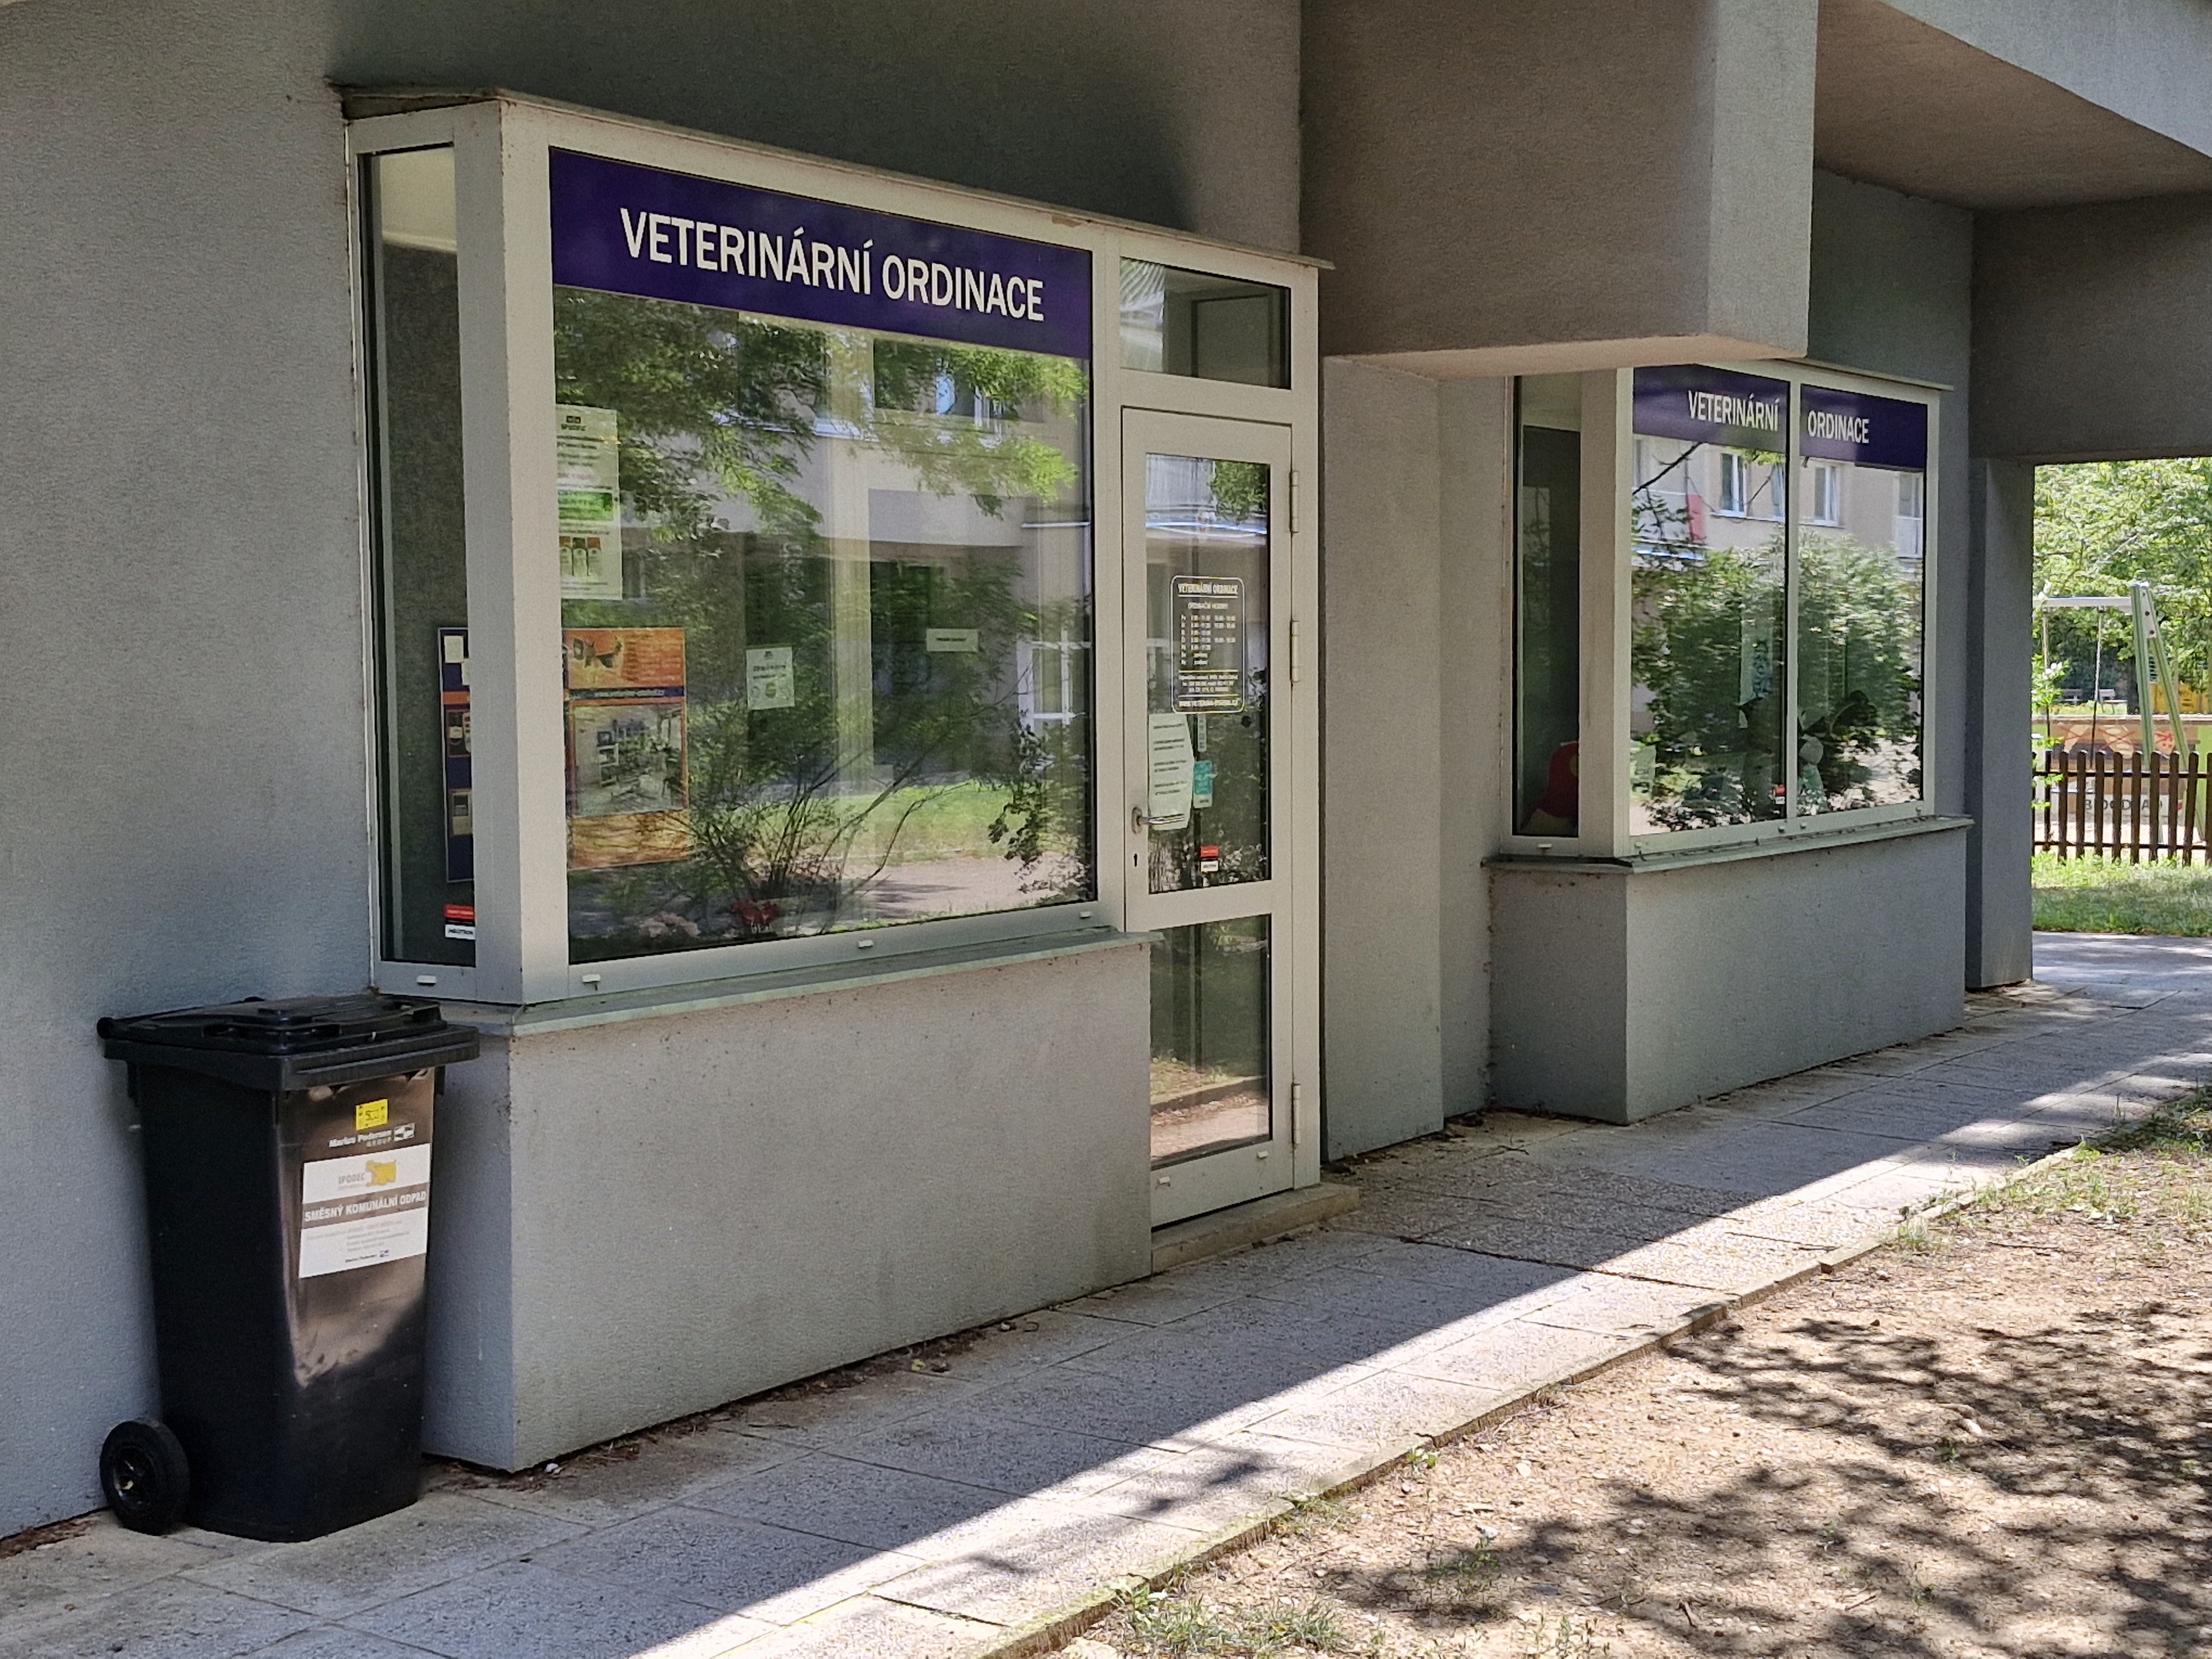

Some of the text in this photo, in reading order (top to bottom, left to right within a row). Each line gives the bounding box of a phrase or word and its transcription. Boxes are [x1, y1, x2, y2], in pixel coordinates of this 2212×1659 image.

[619, 207, 1045, 322] VETERINÁRNÍ ORDINACE
[1687, 390, 1870, 444] VETERINÁRNÍ ORDINACE
[305, 1190, 426, 1222] SMĚSNÝ KOMUNÁLNÍ ODPAD
